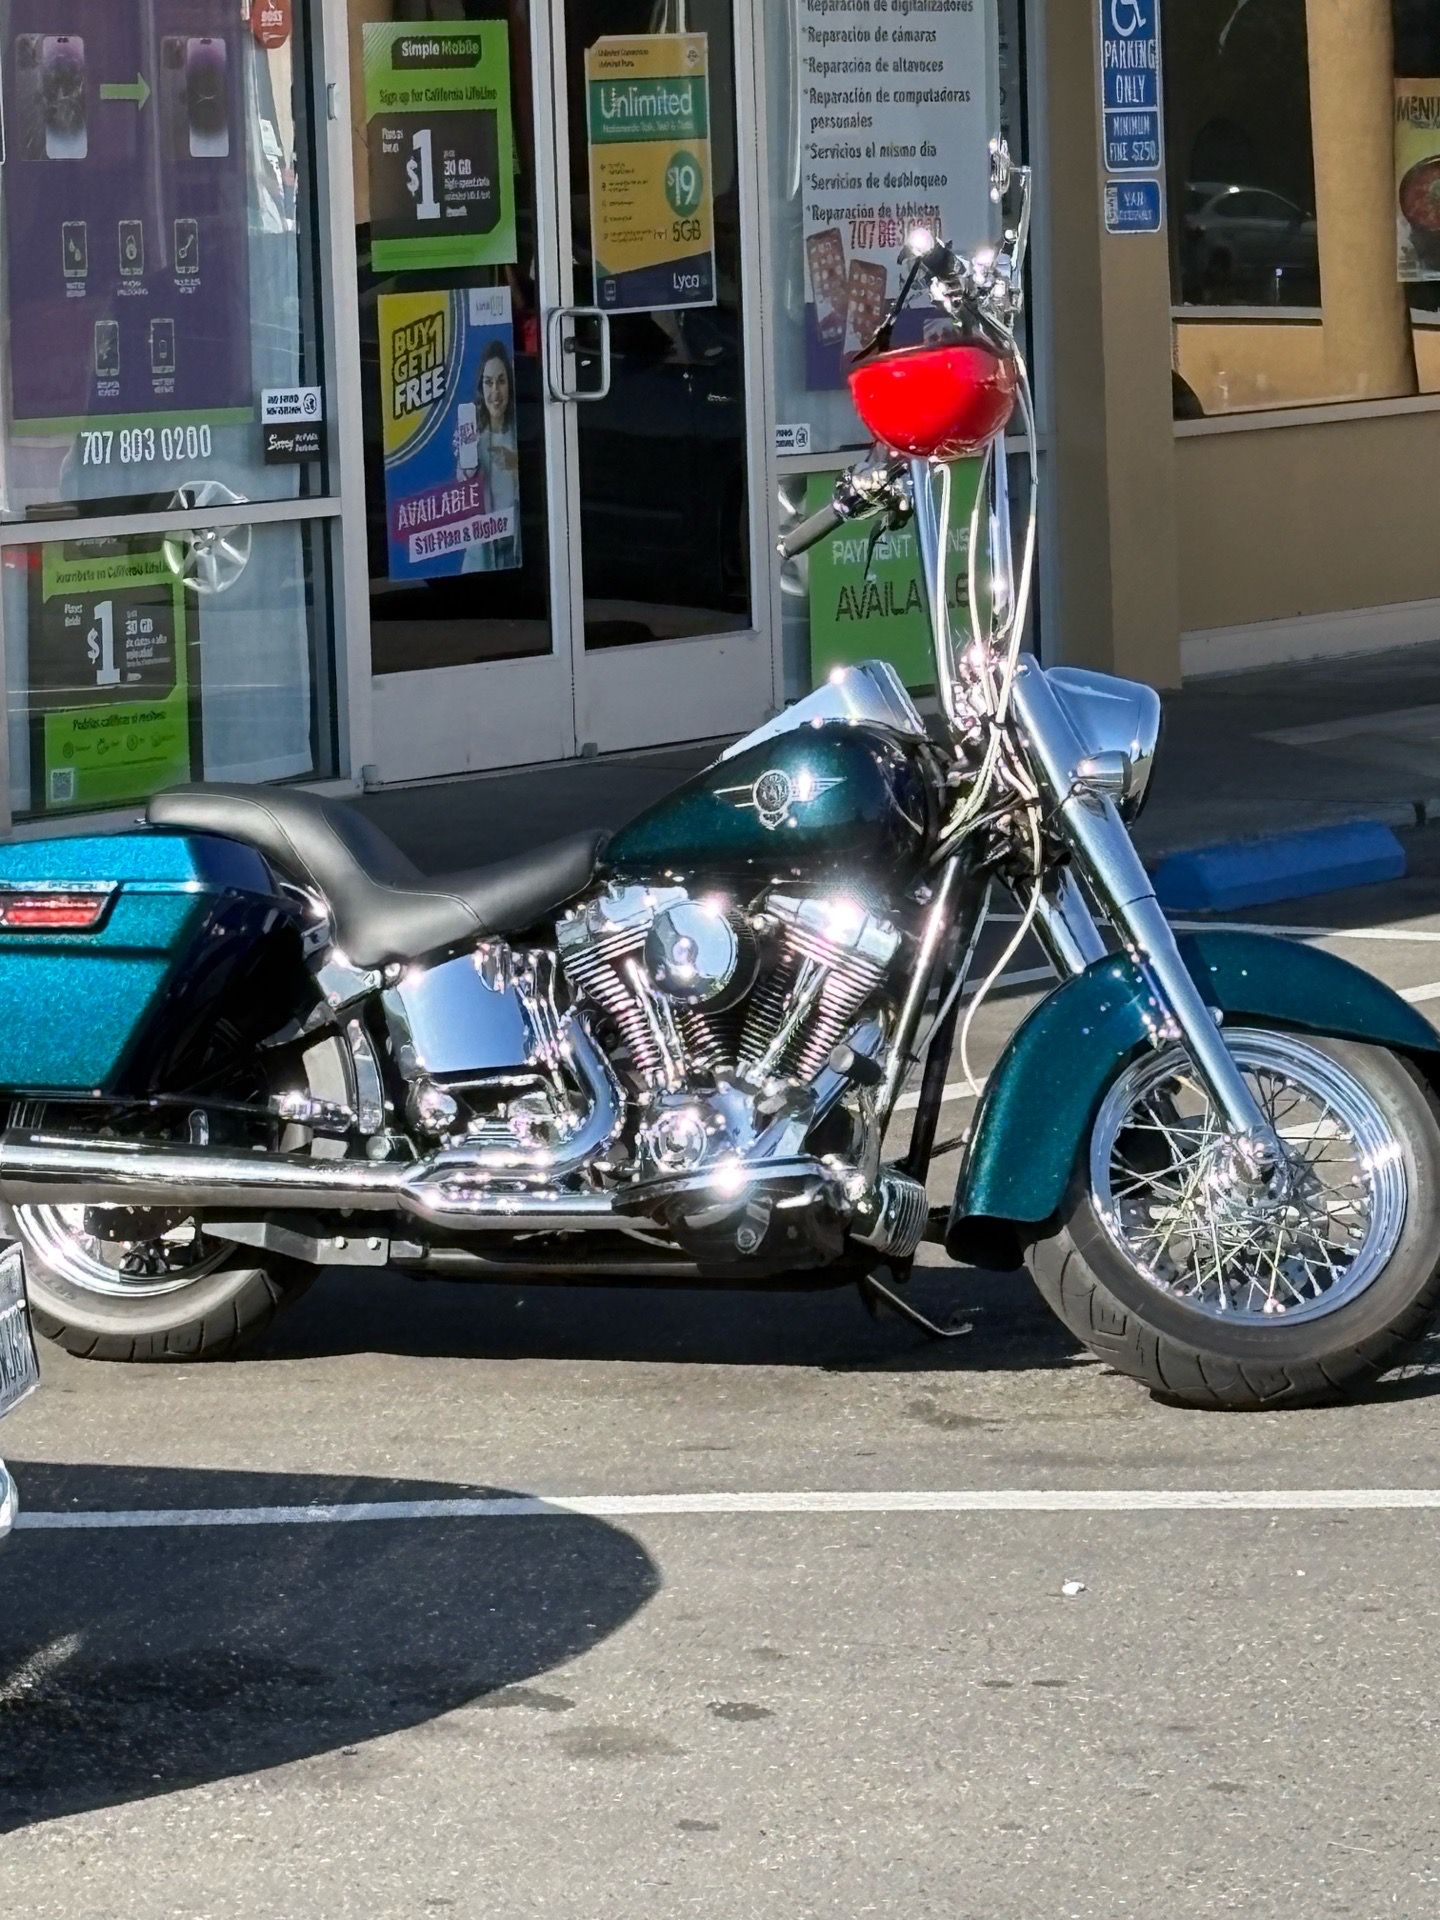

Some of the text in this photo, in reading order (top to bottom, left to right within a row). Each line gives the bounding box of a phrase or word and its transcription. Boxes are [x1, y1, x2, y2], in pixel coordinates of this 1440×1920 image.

[874, 26, 889, 42] de
[892, 25, 937, 42] cámaras
[402, 39, 480, 59] Simple Mobile
[1104, 39, 1157, 69] PARKING
[875, 57, 890, 73] de
[892, 57, 944, 73] altavoces
[411, 88, 424, 102] for
[425, 87, 464, 102] California
[875, 87, 890, 103] de
[893, 87, 971, 106] computadoras
[1116, 74, 1146, 103] ONLY
[601, 83, 692, 118] Unlimited
[810, 112, 873, 133] personales
[1113, 115, 1150, 136] MINIMUM
[810, 141, 862, 159] Servicios
[865, 142, 876, 158] el
[879, 142, 916, 158] mismo
[1109, 140, 1156, 162] FINE $250
[667, 165, 696, 206] $19
[811, 171, 948, 191] Servicios de desbloqueo
[878, 203, 892, 218] de
[673, 272, 700, 292] Lyca
[394, 319, 431, 358] BUY
[393, 344, 430, 383] GET
[394, 365, 445, 416] FREE
[80, 424, 212, 465] 707 803 0200
[398, 483, 480, 531] AVAILABLE
[472, 516, 508, 540] Higher
[835, 572, 970, 623] AVAILAE
[87, 600, 121, 685] $1
